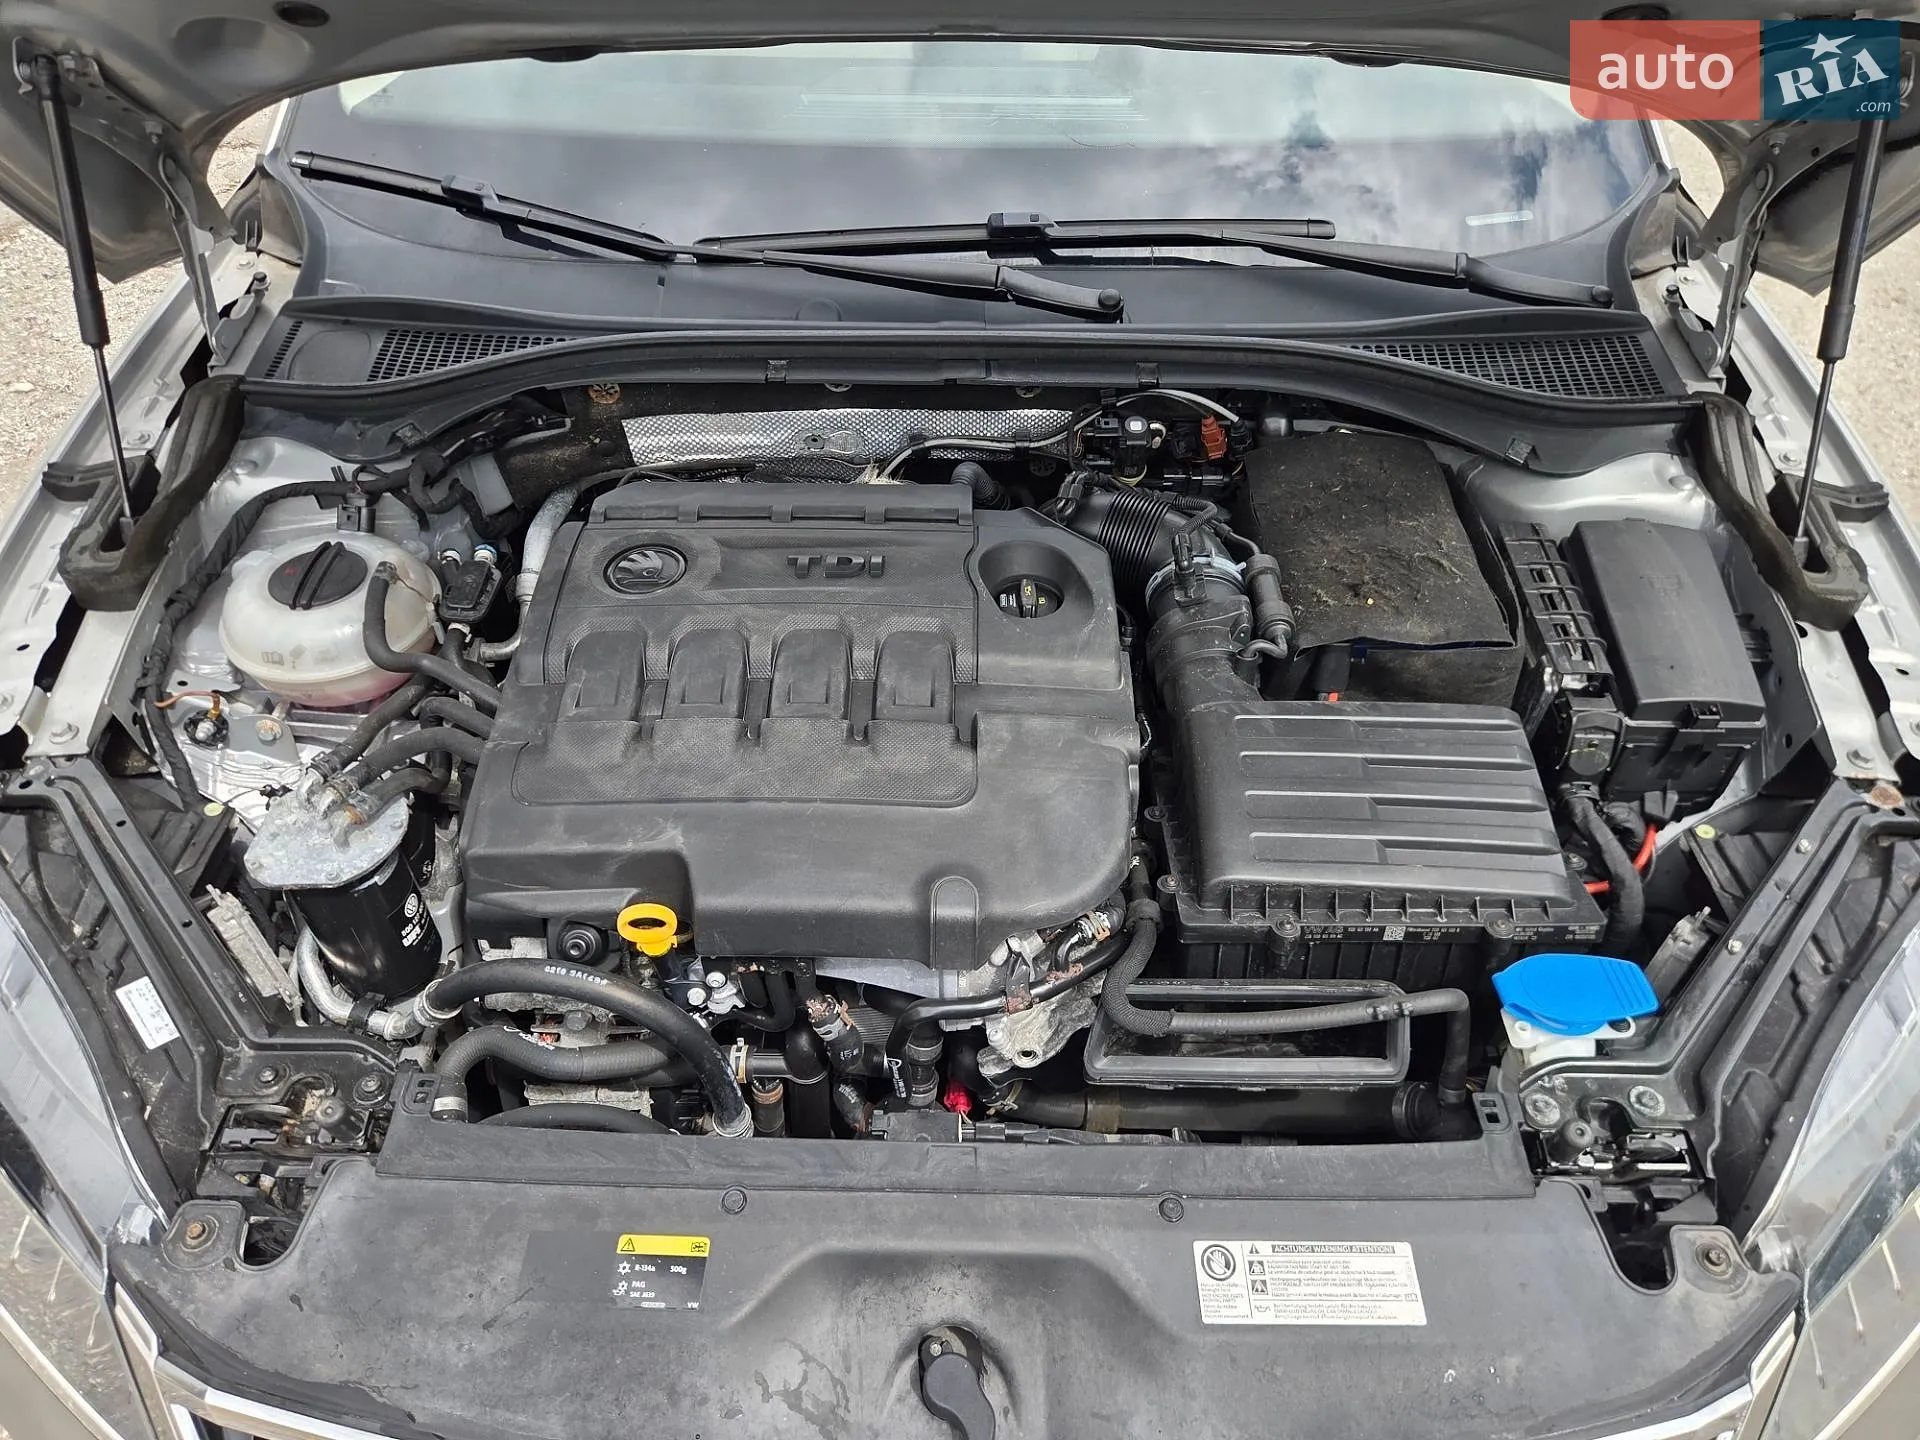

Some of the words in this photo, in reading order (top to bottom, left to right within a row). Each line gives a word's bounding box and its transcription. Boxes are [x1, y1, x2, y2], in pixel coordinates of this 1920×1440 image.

[787, 554, 885, 579] TDI
[1274, 1244, 1312, 1253] ACHTUNG!
[1313, 1244, 1351, 1253] WARNING!
[1352, 1245, 1395, 1253] ATTENTION!
[670, 1265, 687, 1274] 500g
